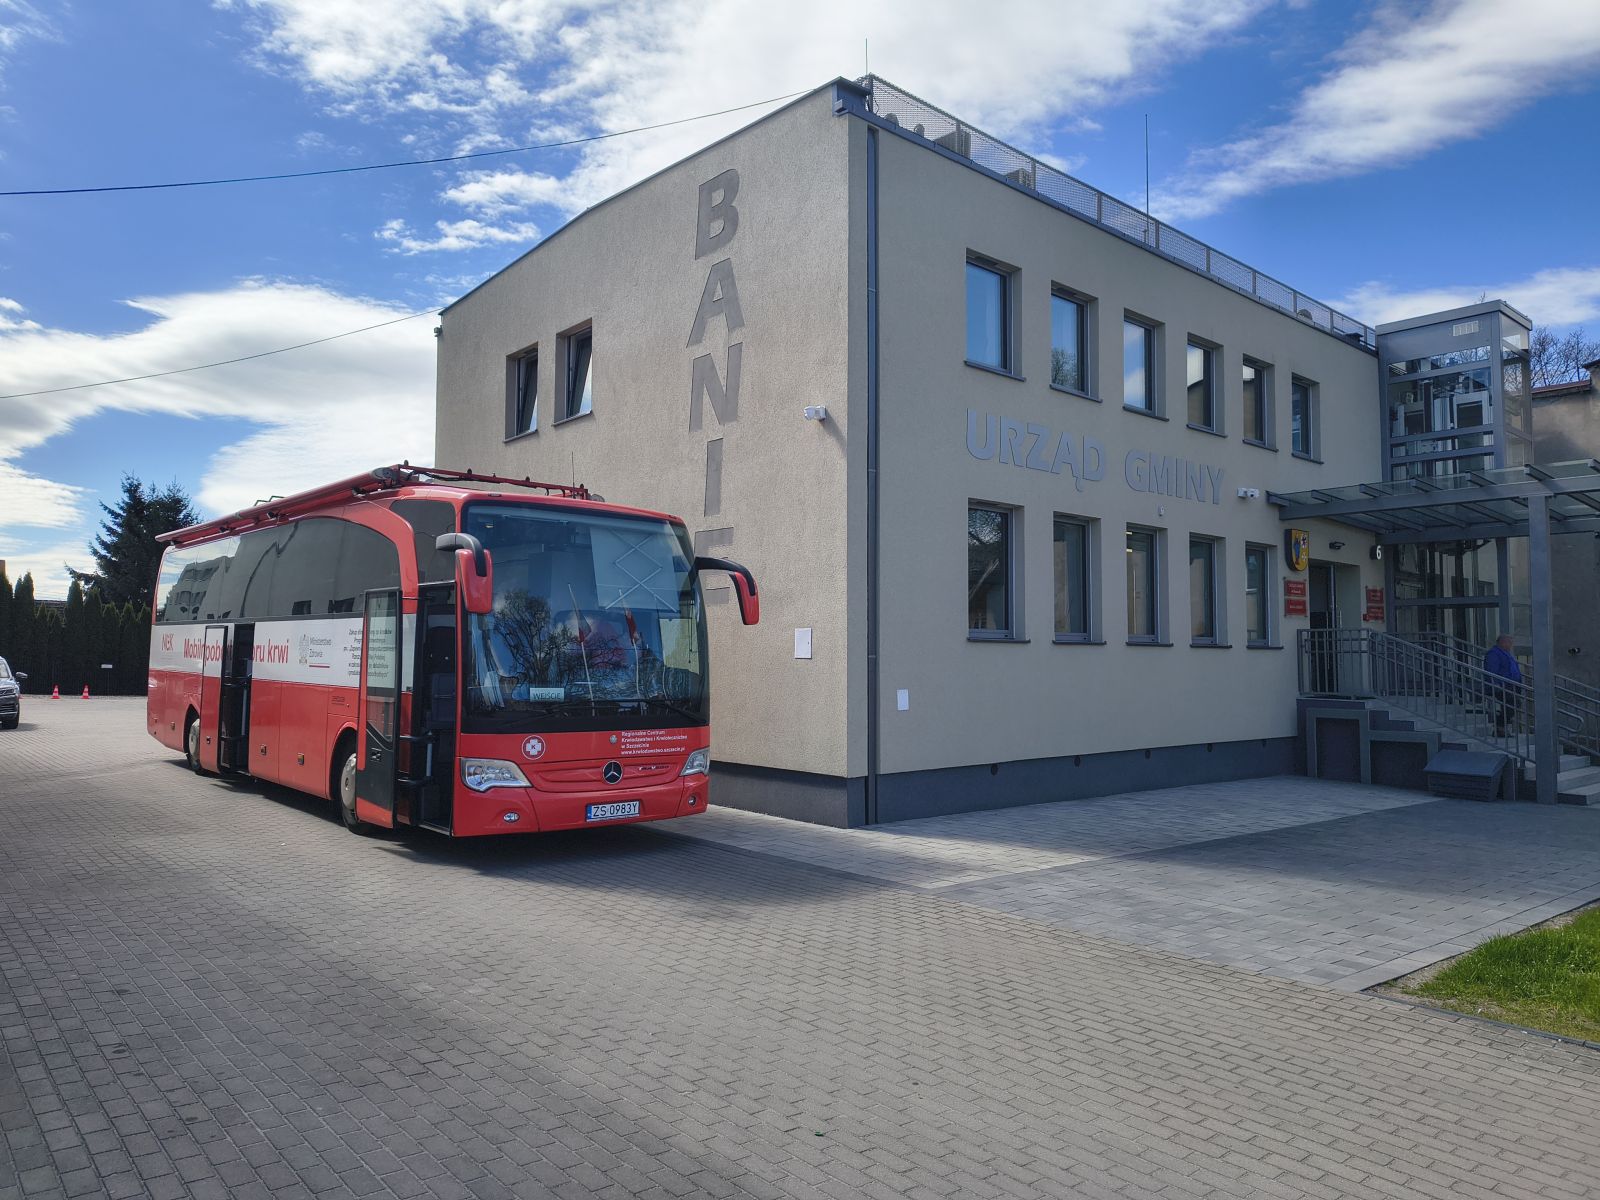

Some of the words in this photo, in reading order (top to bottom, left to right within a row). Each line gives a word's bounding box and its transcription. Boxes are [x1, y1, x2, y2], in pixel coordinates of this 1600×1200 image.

[966, 408, 1106, 492] URZĄD
[1124, 449, 1225, 505] GMINY
[1376, 545, 1382, 560] 6
[267, 638, 289, 664] krwi
[593, 805, 607, 817] ZS
[609, 802, 638, 815] 0983Y
